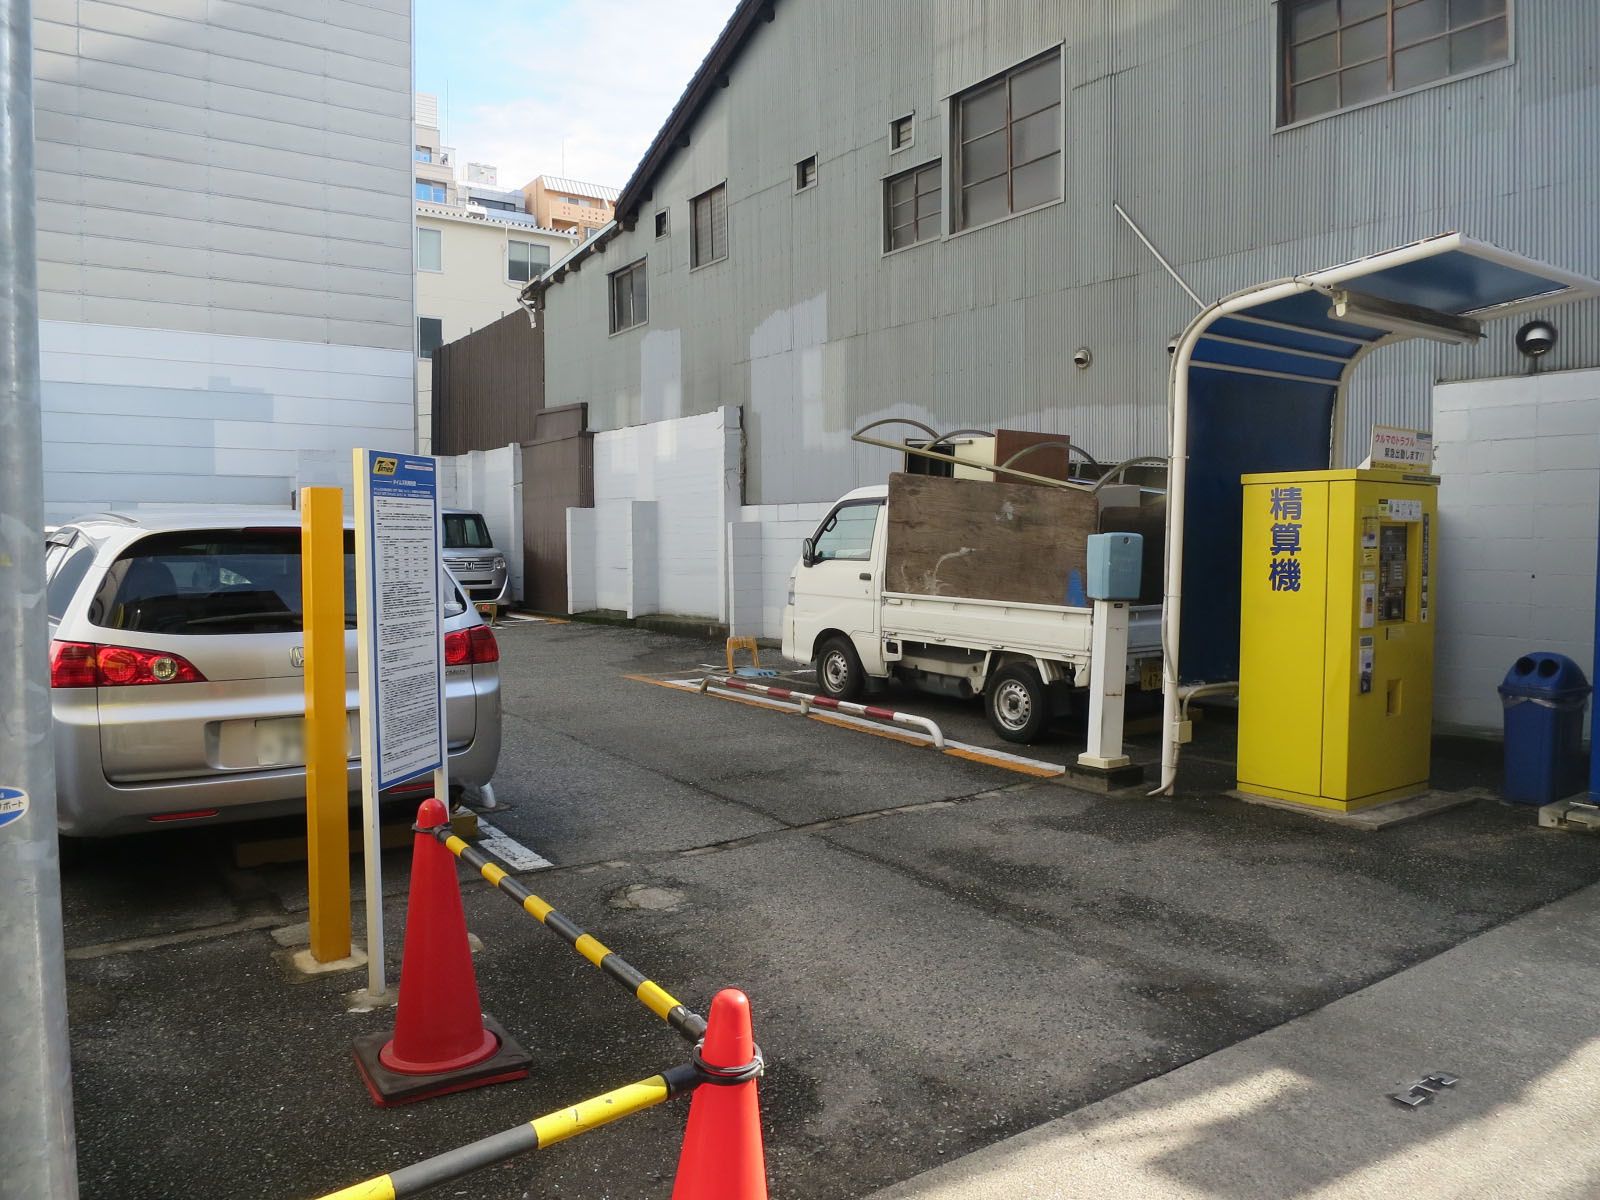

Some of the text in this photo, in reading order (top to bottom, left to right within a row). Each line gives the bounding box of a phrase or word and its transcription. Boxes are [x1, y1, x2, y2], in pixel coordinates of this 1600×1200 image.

[1269, 487, 1302, 592] 精算機
[0, 800, 24, 811] ポート
